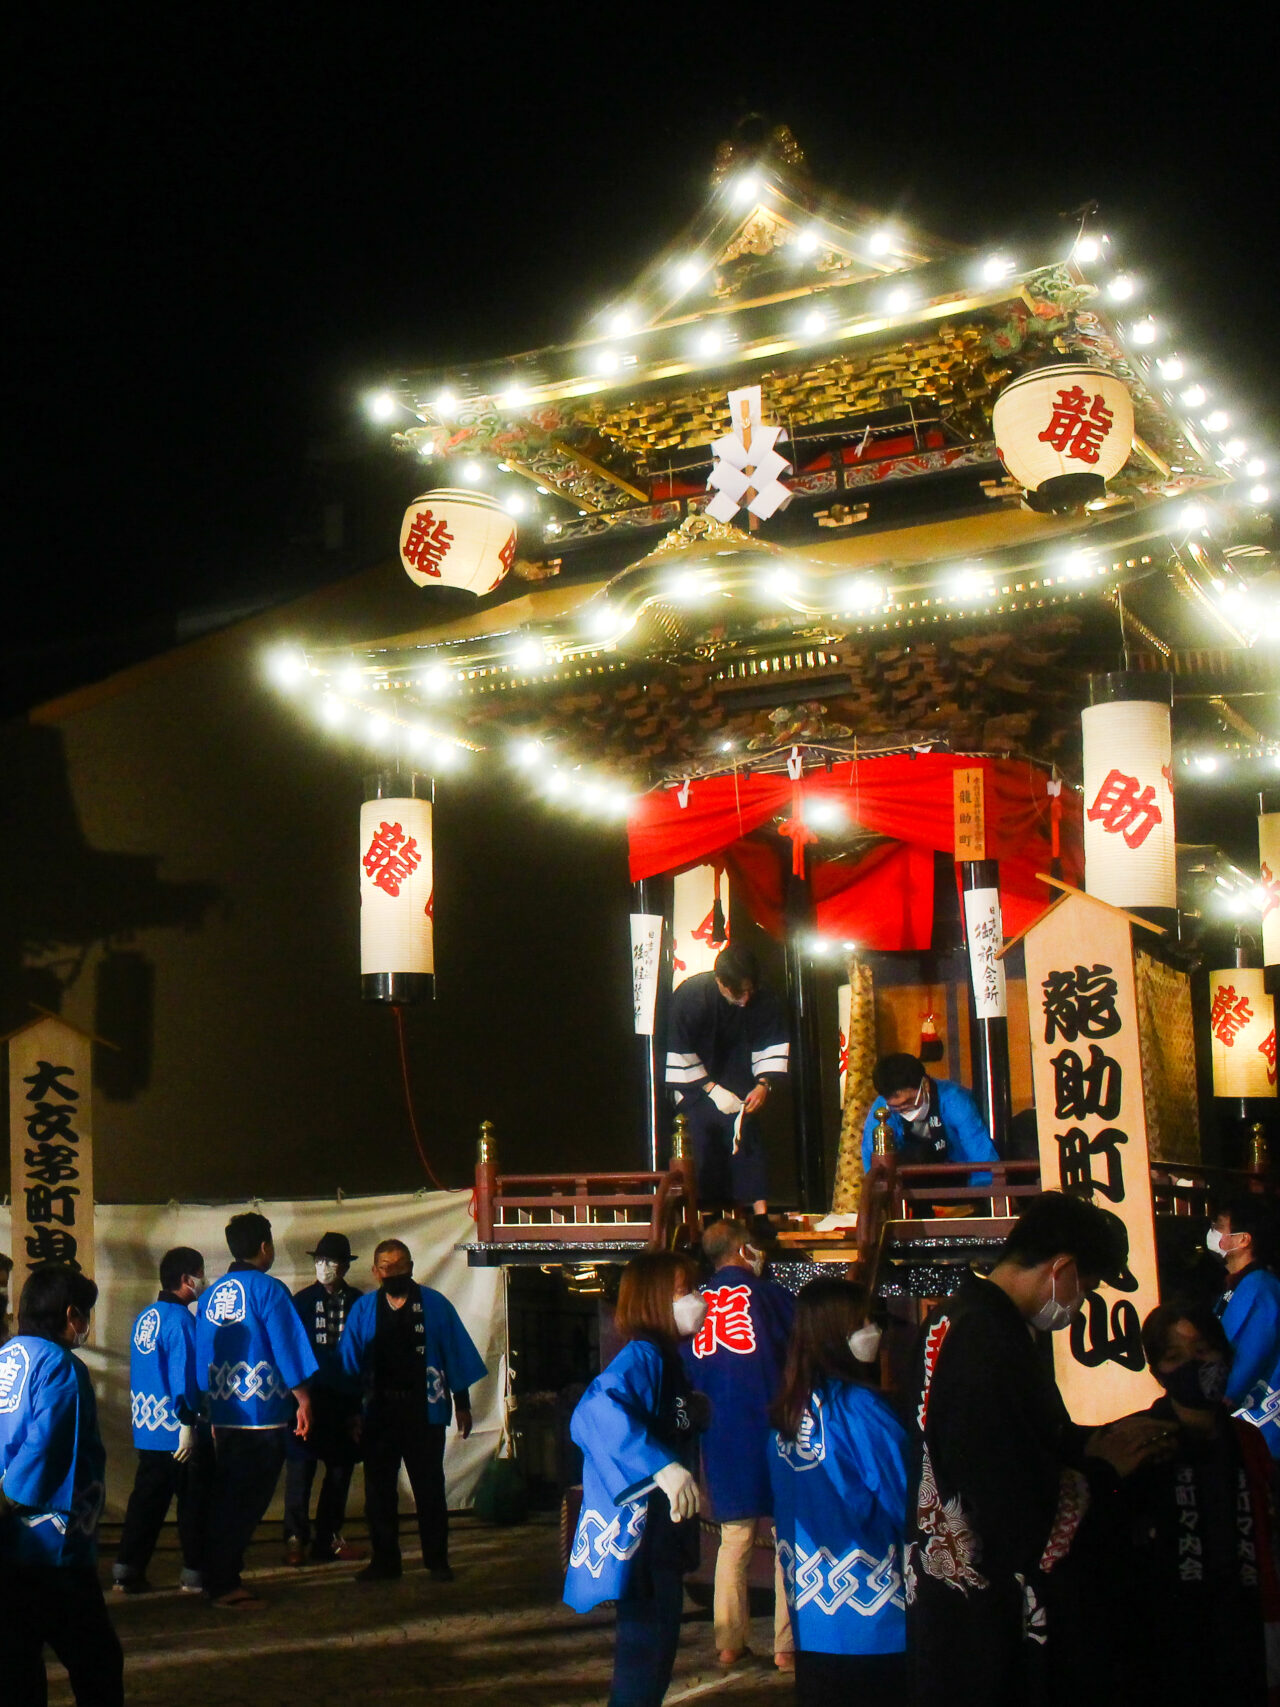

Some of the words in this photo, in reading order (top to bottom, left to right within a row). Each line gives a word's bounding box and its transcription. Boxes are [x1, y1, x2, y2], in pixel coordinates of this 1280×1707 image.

[1038, 385, 1113, 464] 龍
[403, 509, 454, 577] 龍
[1087, 769, 1162, 849] 助
[363, 822, 421, 897] 龍
[1210, 984, 1254, 1048] 龍
[138, 1315, 156, 1348] 龍
[214, 1288, 238, 1320] 龍
[692, 1285, 756, 1359] 龍
